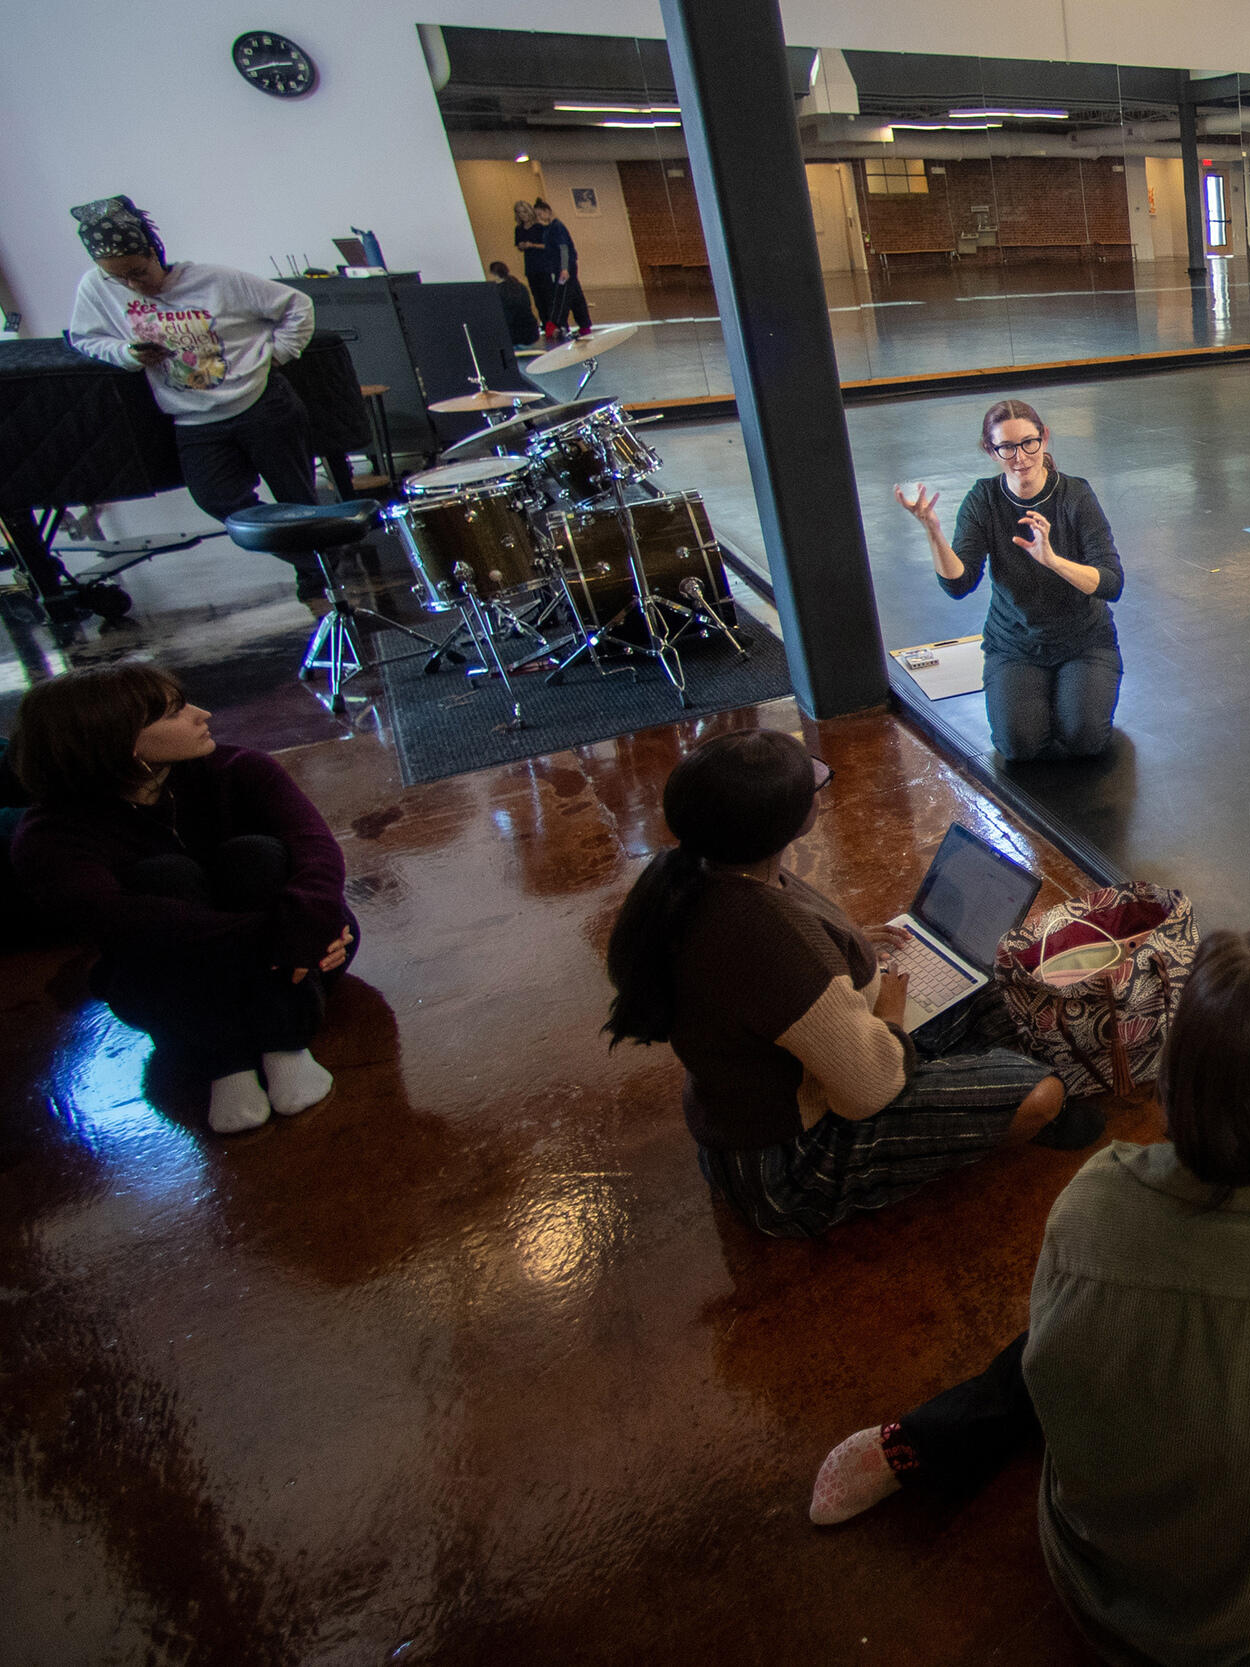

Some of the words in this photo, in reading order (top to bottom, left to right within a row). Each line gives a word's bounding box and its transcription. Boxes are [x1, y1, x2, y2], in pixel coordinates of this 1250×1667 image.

[127, 300, 157, 316] Les
[157, 309, 213, 322] FRUITS
[165, 321, 192, 335] du
